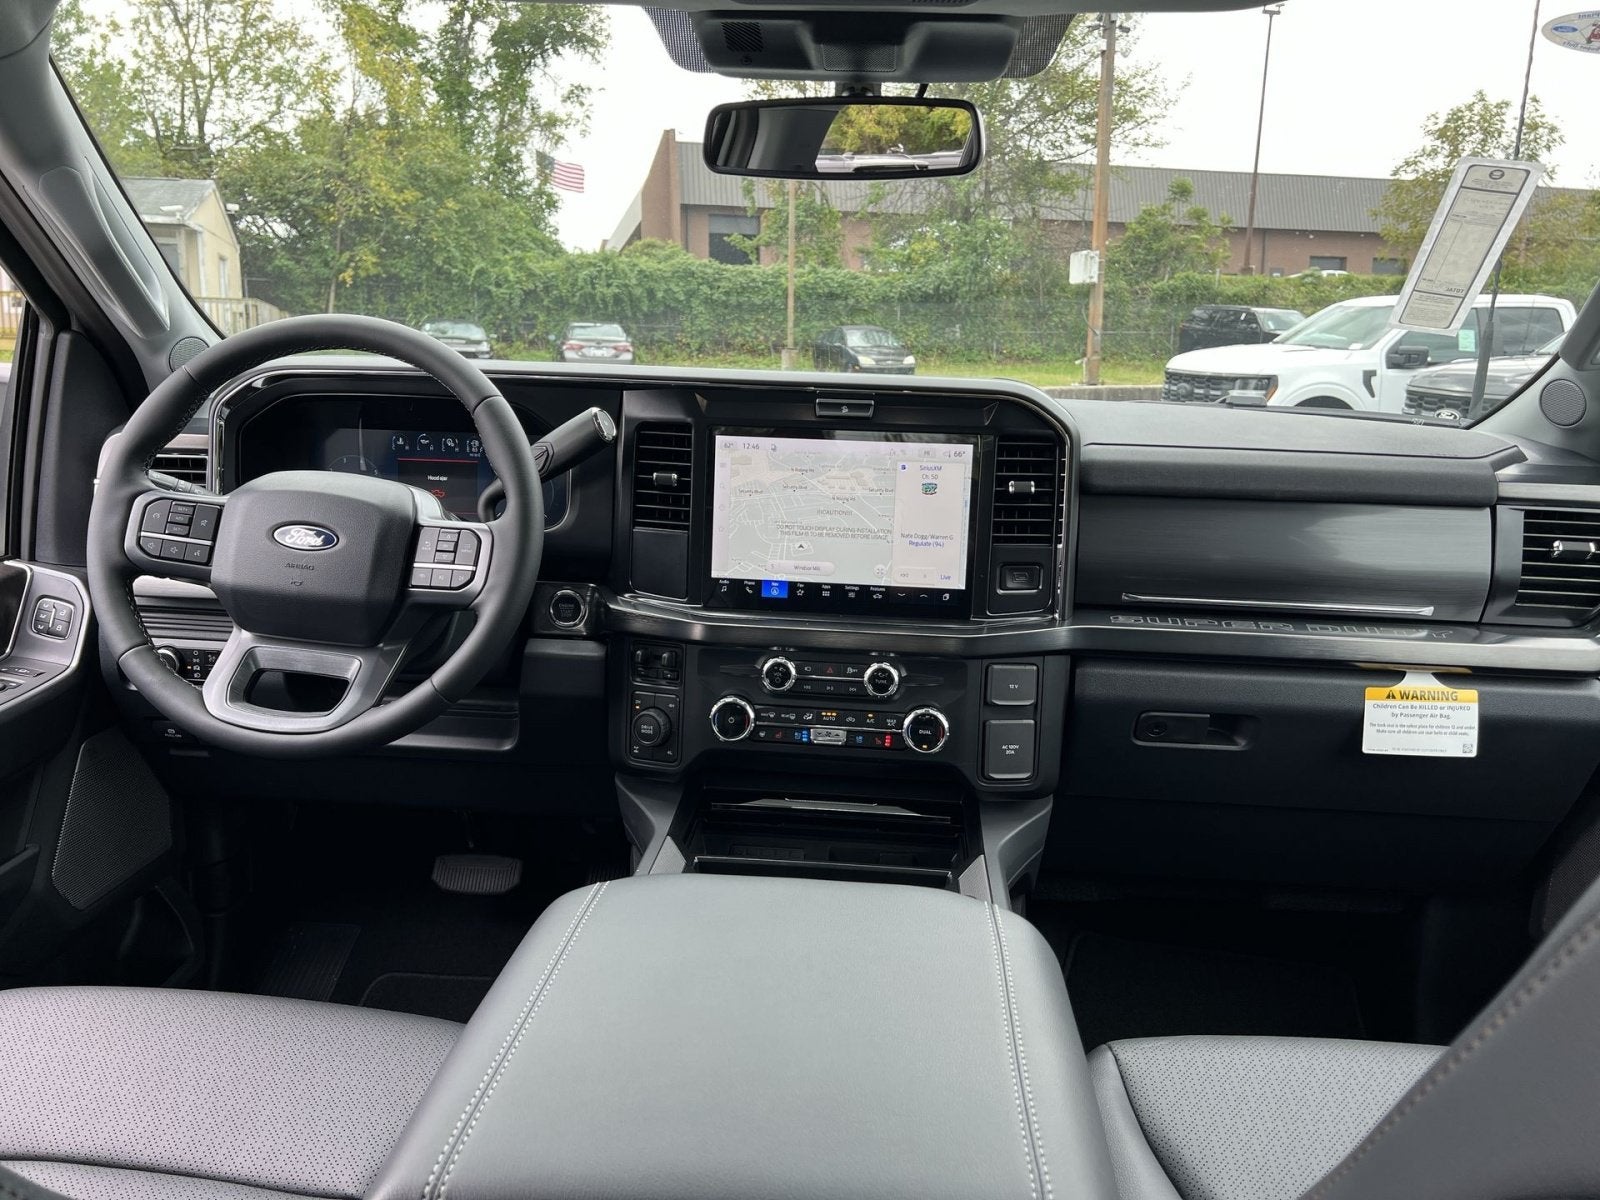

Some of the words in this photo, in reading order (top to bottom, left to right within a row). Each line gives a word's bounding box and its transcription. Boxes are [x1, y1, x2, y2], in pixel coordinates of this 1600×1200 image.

[286, 528, 325, 546] Ford
[1110, 615, 1294, 631] SUPER
[1399, 690, 1458, 701] WARNING
